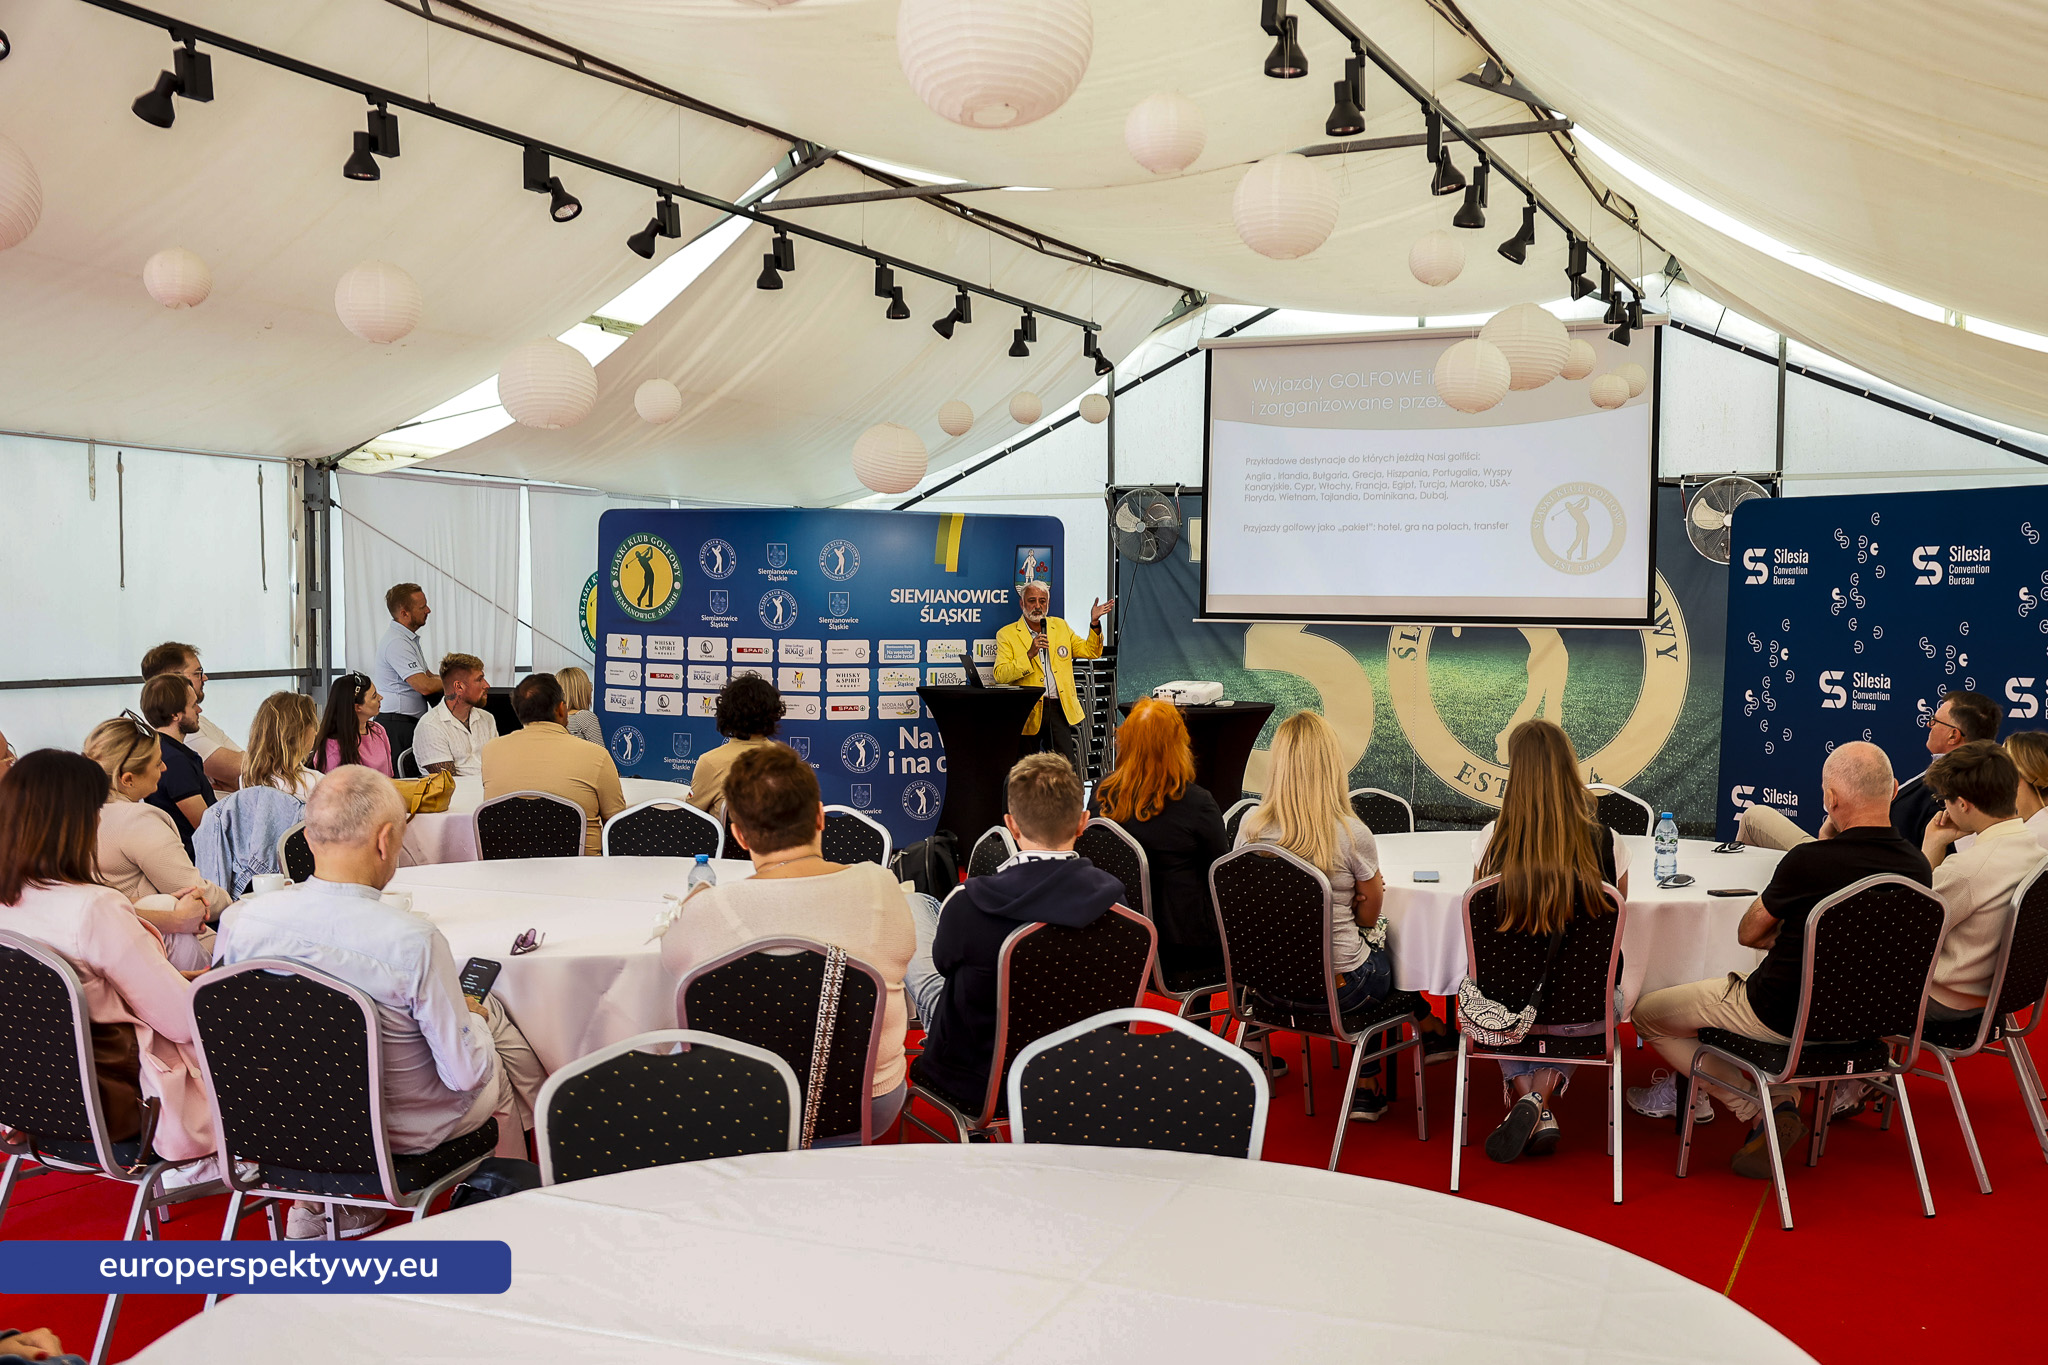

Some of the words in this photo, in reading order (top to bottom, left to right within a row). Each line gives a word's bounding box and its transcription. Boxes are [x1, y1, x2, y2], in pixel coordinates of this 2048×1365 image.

[1252, 375, 1324, 396] Wyjazdy
[1329, 370, 1422, 388] GOLFOWE
[1251, 400, 1255, 415] i
[1260, 396, 1394, 418] zorganizowane
[1246, 457, 1297, 467] Przykładowe
[1300, 456, 1346, 466] destynacje
[1348, 454, 1360, 464] do
[1362, 453, 1394, 464] których
[1427, 452, 1446, 461] Nasi
[1483, 468, 1512, 477] Wyspy
[1450, 479, 1486, 488] Maroko,
[1243, 524, 1280, 533] Przyjazdy
[1282, 523, 1315, 533] golfowy
[1317, 523, 1335, 532] jako
[1404, 524, 1420, 532] gra
[1436, 522, 1471, 532] polach,
[1474, 522, 1509, 530] transfer
[628, 535, 648, 546] KLUB
[650, 537, 681, 577] GOLFOWY
[1774, 548, 1809, 564] Silesia
[1949, 545, 1991, 562] Silesia
[1773, 566, 1808, 575] Convention
[1949, 564, 1990, 574] Convention
[1773, 576, 1795, 585] Bureau
[1949, 575, 1974, 585] Bureau
[890, 589, 1009, 604] SIEMIANOWICE
[615, 590, 656, 619] SIEMIANOWICE
[920, 605, 981, 626] ŚLĄSKIE
[1853, 672, 1891, 689] Silesia
[1852, 690, 1890, 700] Convention
[1852, 700, 1876, 710] Bureau
[899, 726, 933, 749] Na
[888, 751, 895, 774] i
[901, 756, 930, 774] na
[1763, 788, 1798, 806] Silesia
